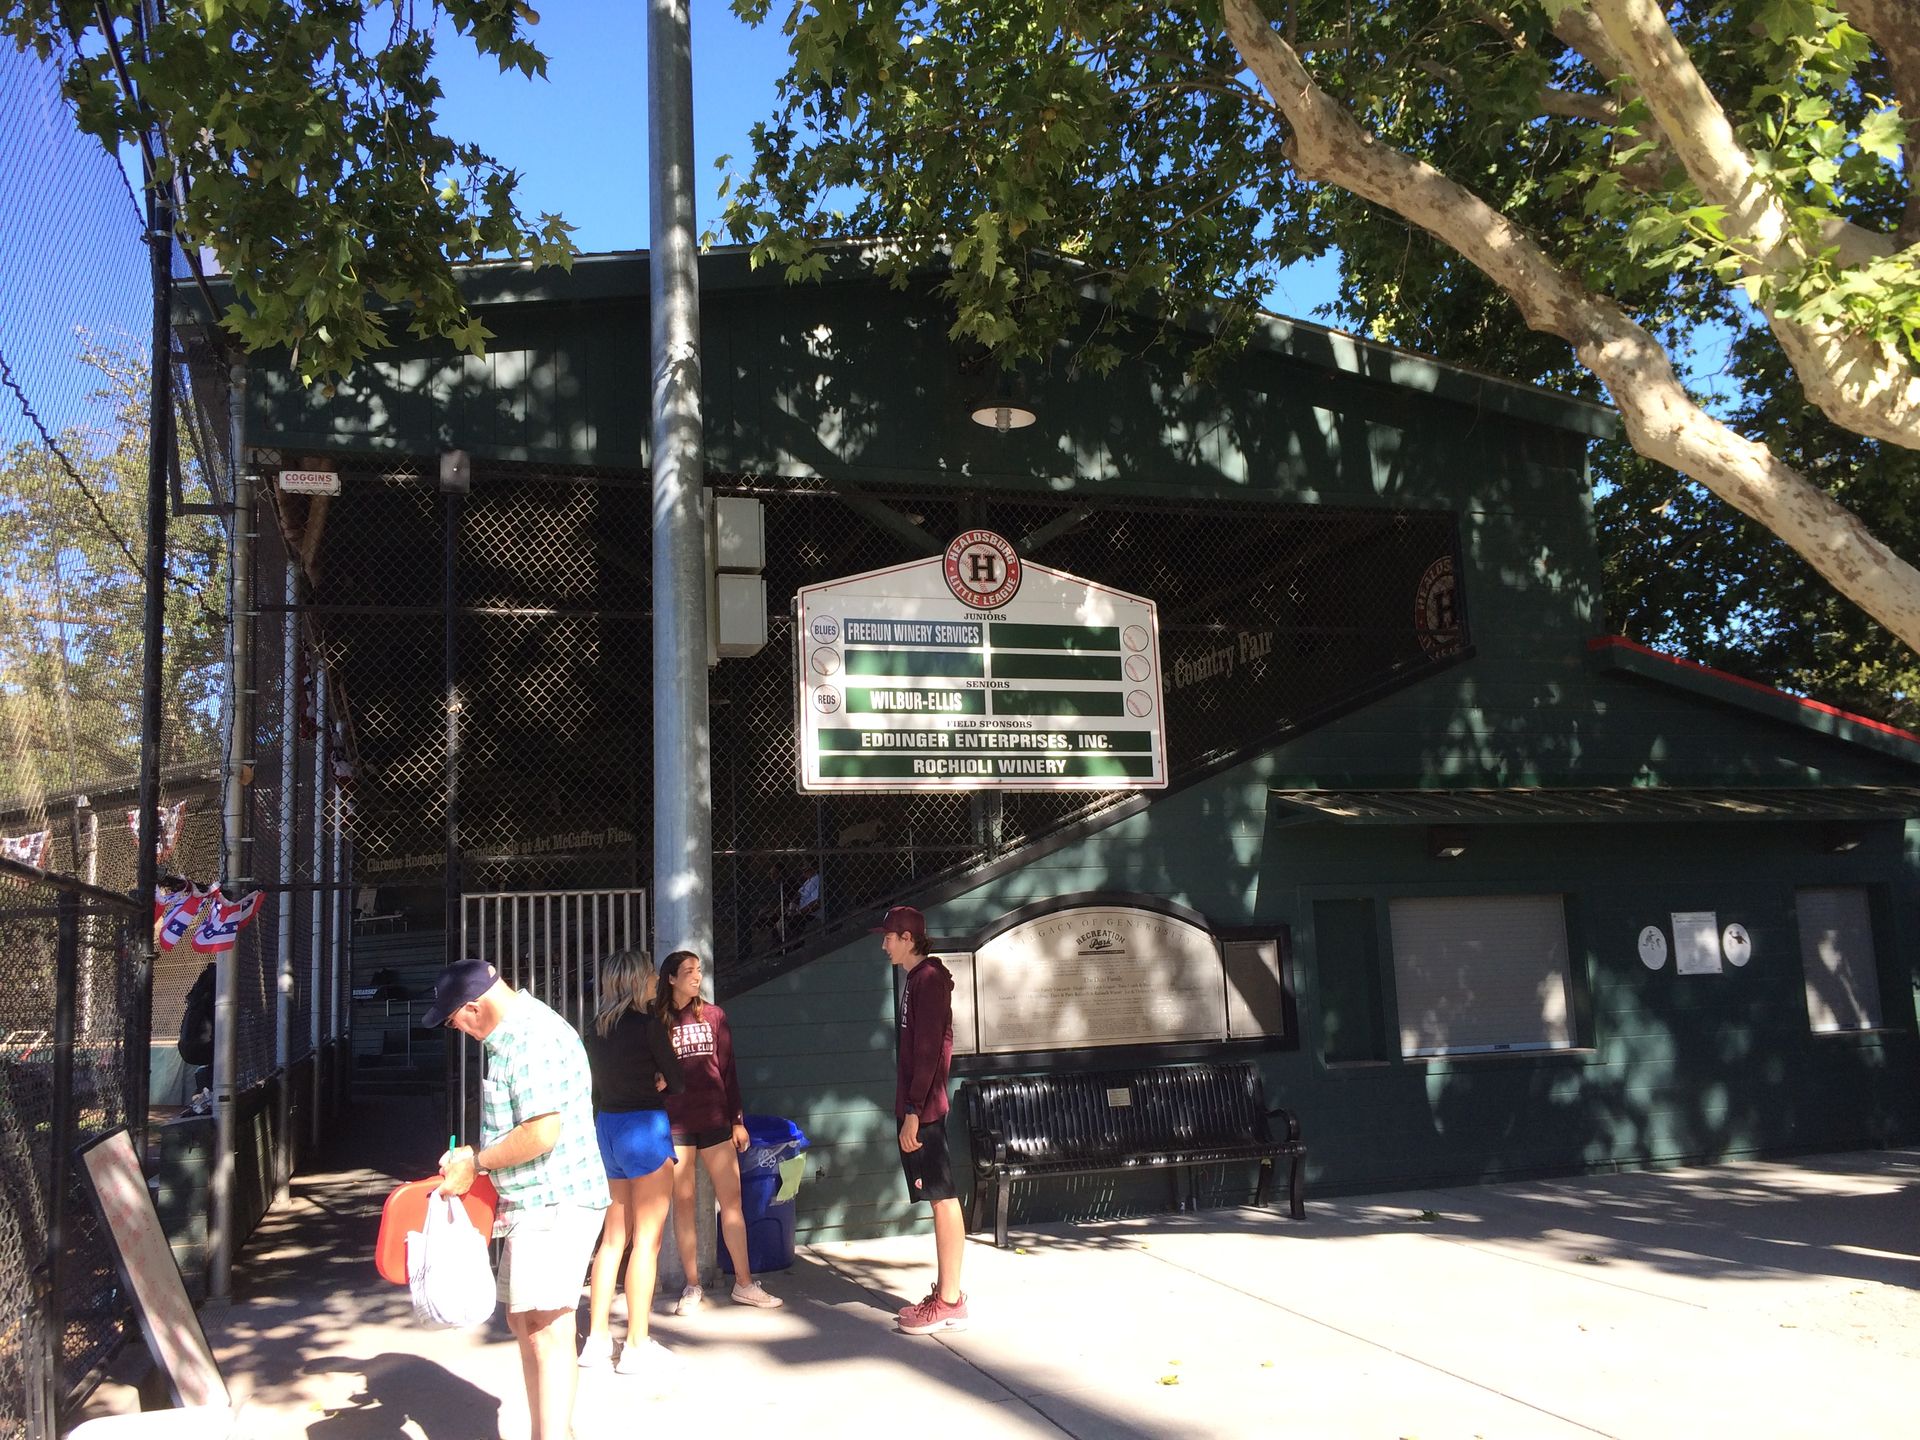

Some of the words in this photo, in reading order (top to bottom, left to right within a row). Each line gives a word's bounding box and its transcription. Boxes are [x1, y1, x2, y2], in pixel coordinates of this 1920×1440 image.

[285, 473, 332, 482] COGGINS
[949, 533, 1016, 565] HEALDSBURG
[968, 553, 998, 583] H
[949, 574, 981, 605] LITTLE
[983, 576, 1017, 605] LEAGUE
[964, 612, 1007, 621] JUNIORS
[814, 625, 837, 636] BLUES
[848, 622, 892, 642] FREERUN
[894, 624, 933, 643] WINERY
[935, 626, 979, 644] SERVICES
[1237, 631, 1273, 665] Fair
[966, 680, 1010, 688] SENIORS
[817, 694, 836, 705] REDS
[869, 690, 963, 712] WILBUR-ELLIS
[979, 720, 1032, 728] SPONSORS
[861, 732, 950, 748] EDDINGER
[955, 733, 1073, 750] ENTERPRISES,
[1078, 734, 1113, 748] INC.
[913, 759, 993, 774] ROCHIOLI
[998, 759, 1067, 774] WINERY
[1081, 918, 1098, 927] OF
[1076, 929, 1126, 945] RECREATION
[1089, 937, 1113, 950] Park
